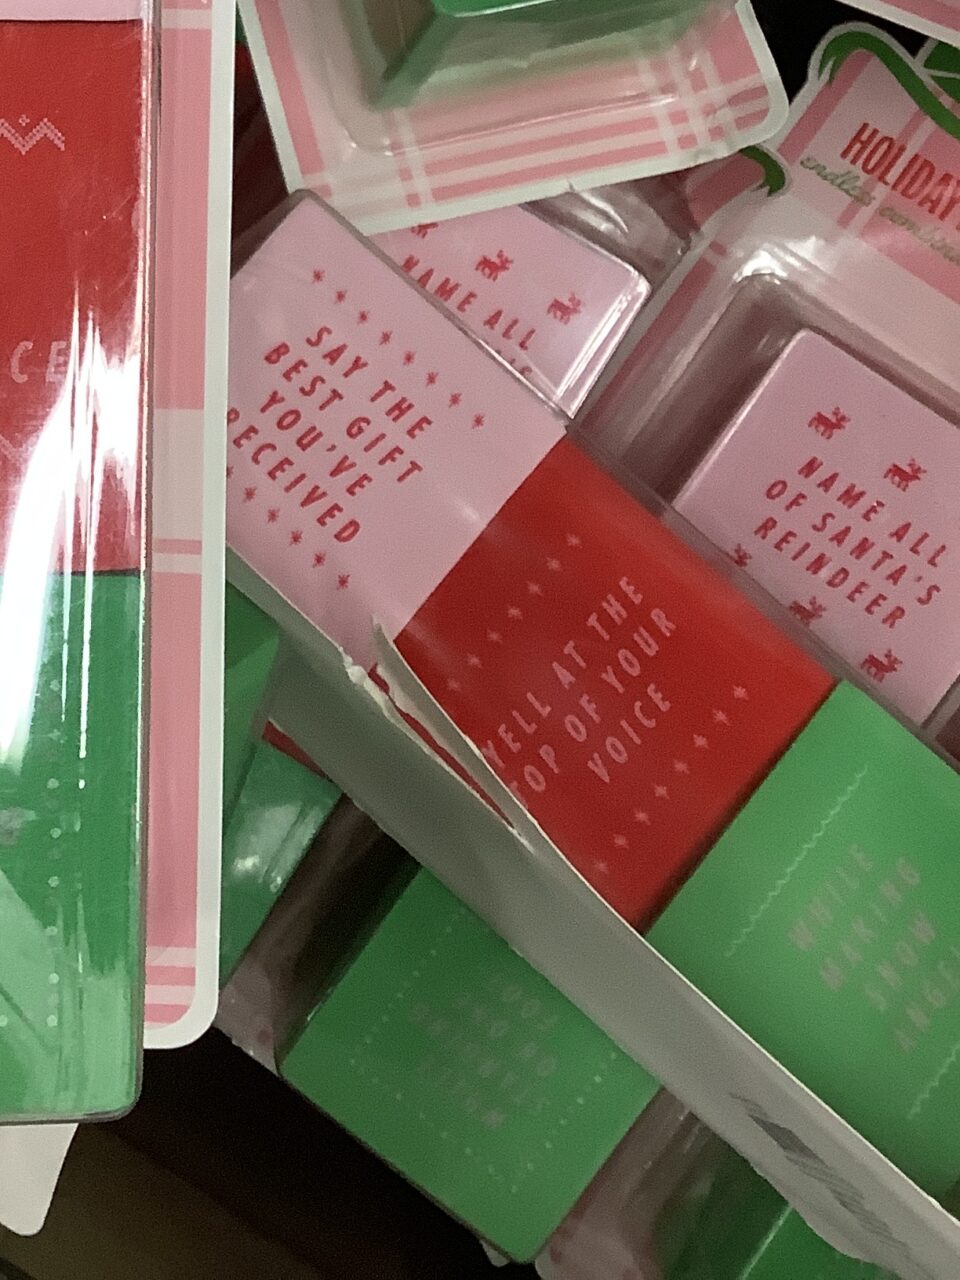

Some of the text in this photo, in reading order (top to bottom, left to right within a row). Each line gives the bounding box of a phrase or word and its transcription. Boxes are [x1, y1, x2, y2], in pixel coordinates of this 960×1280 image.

[402, 255, 536, 351] NAME ALL
[264, 342, 424, 483] BEST GIFT
[306, 326, 433, 440] SAY THE
[260, 390, 373, 497] YOU'VE
[766, 480, 941, 605] OF SANTA'S
[797, 456, 946, 568] NAME ALL
[754, 517, 906, 629] REINDEER
[481, 576, 643, 769] YELL AT THE
[564, 607, 677, 743] OF YOUR
[587, 682, 672, 784] VOICE
